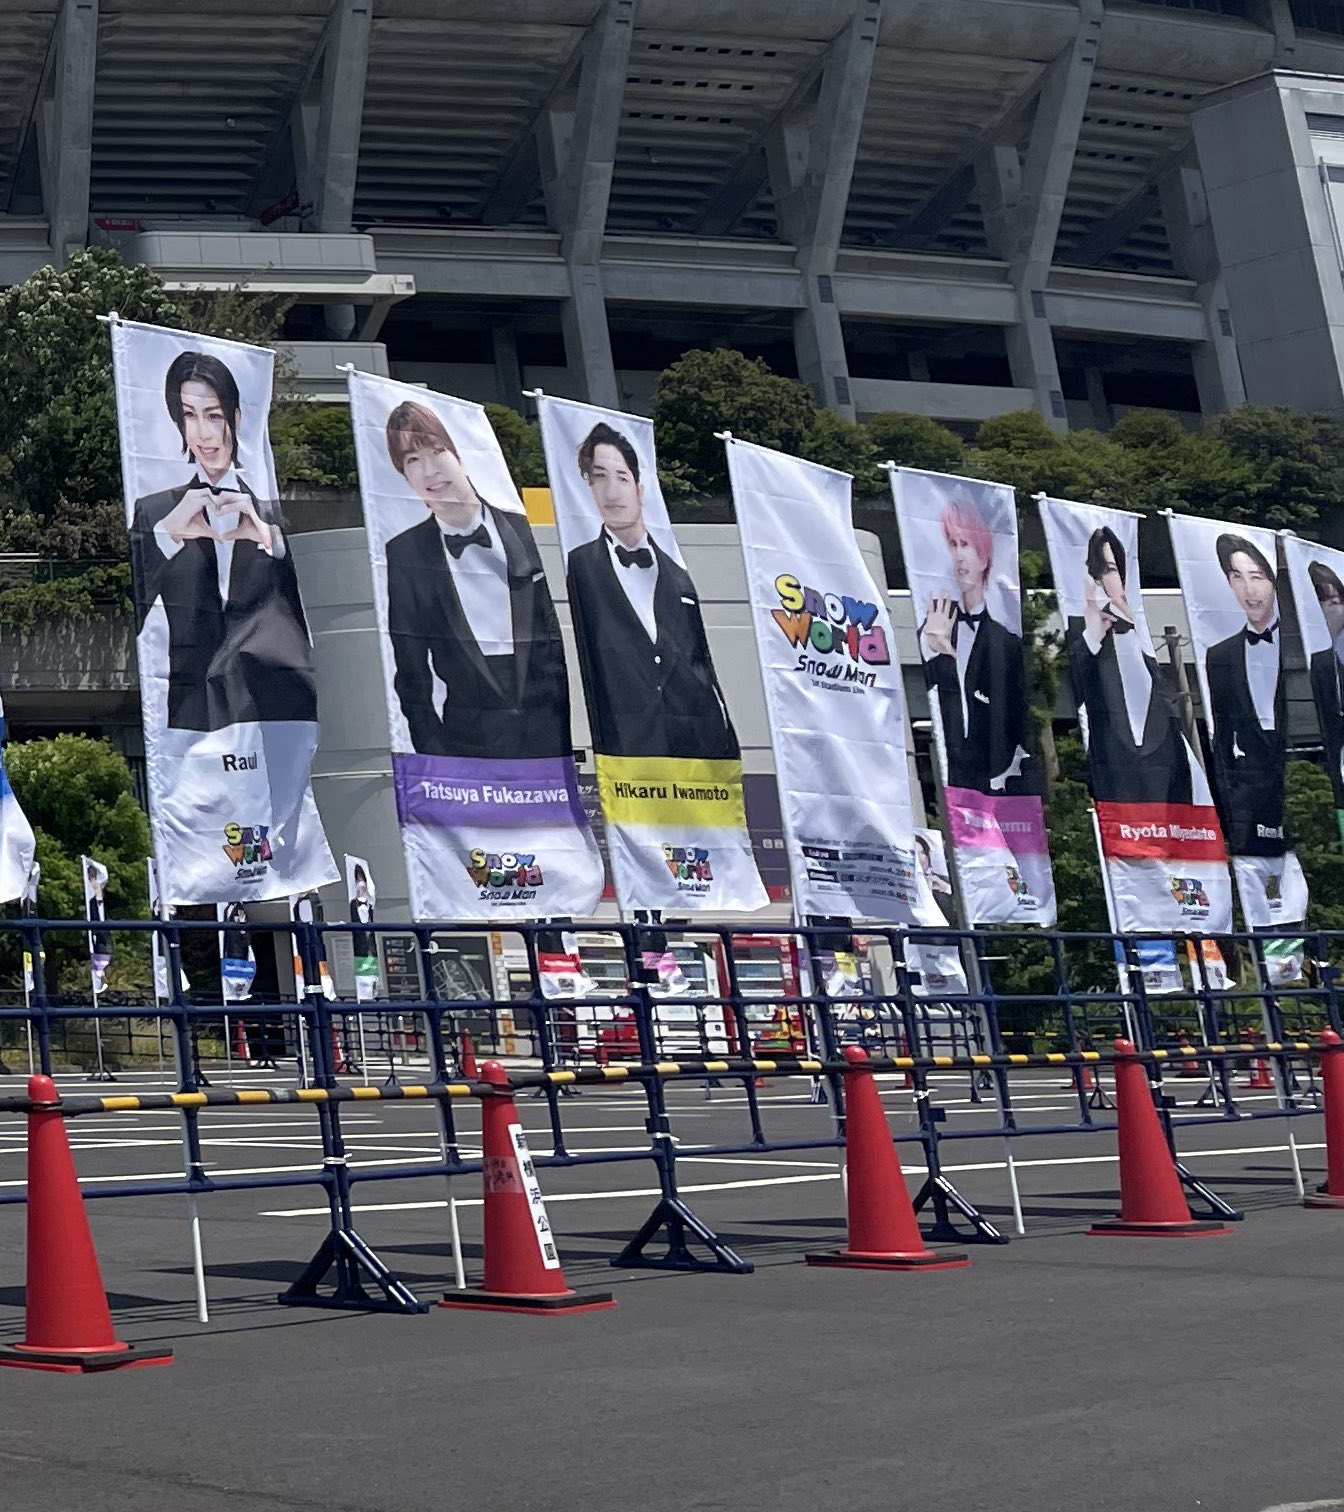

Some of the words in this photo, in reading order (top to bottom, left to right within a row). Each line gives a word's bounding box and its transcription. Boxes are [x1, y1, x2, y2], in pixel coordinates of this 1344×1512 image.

[775, 574, 878, 631] Snow
[771, 609, 890, 665] World
[794, 654, 842, 679] Snow
[843, 664, 876, 688] Man
[222, 751, 258, 772] Raul
[421, 781, 480, 805] Tatsuya
[481, 785, 569, 804] Fukazawa
[614, 782, 667, 799] Hikaru
[673, 784, 729, 801] Iwamoto
[1120, 824, 1168, 841] Ryota
[469, 848, 536, 870] Snow
[466, 864, 544, 888] World
